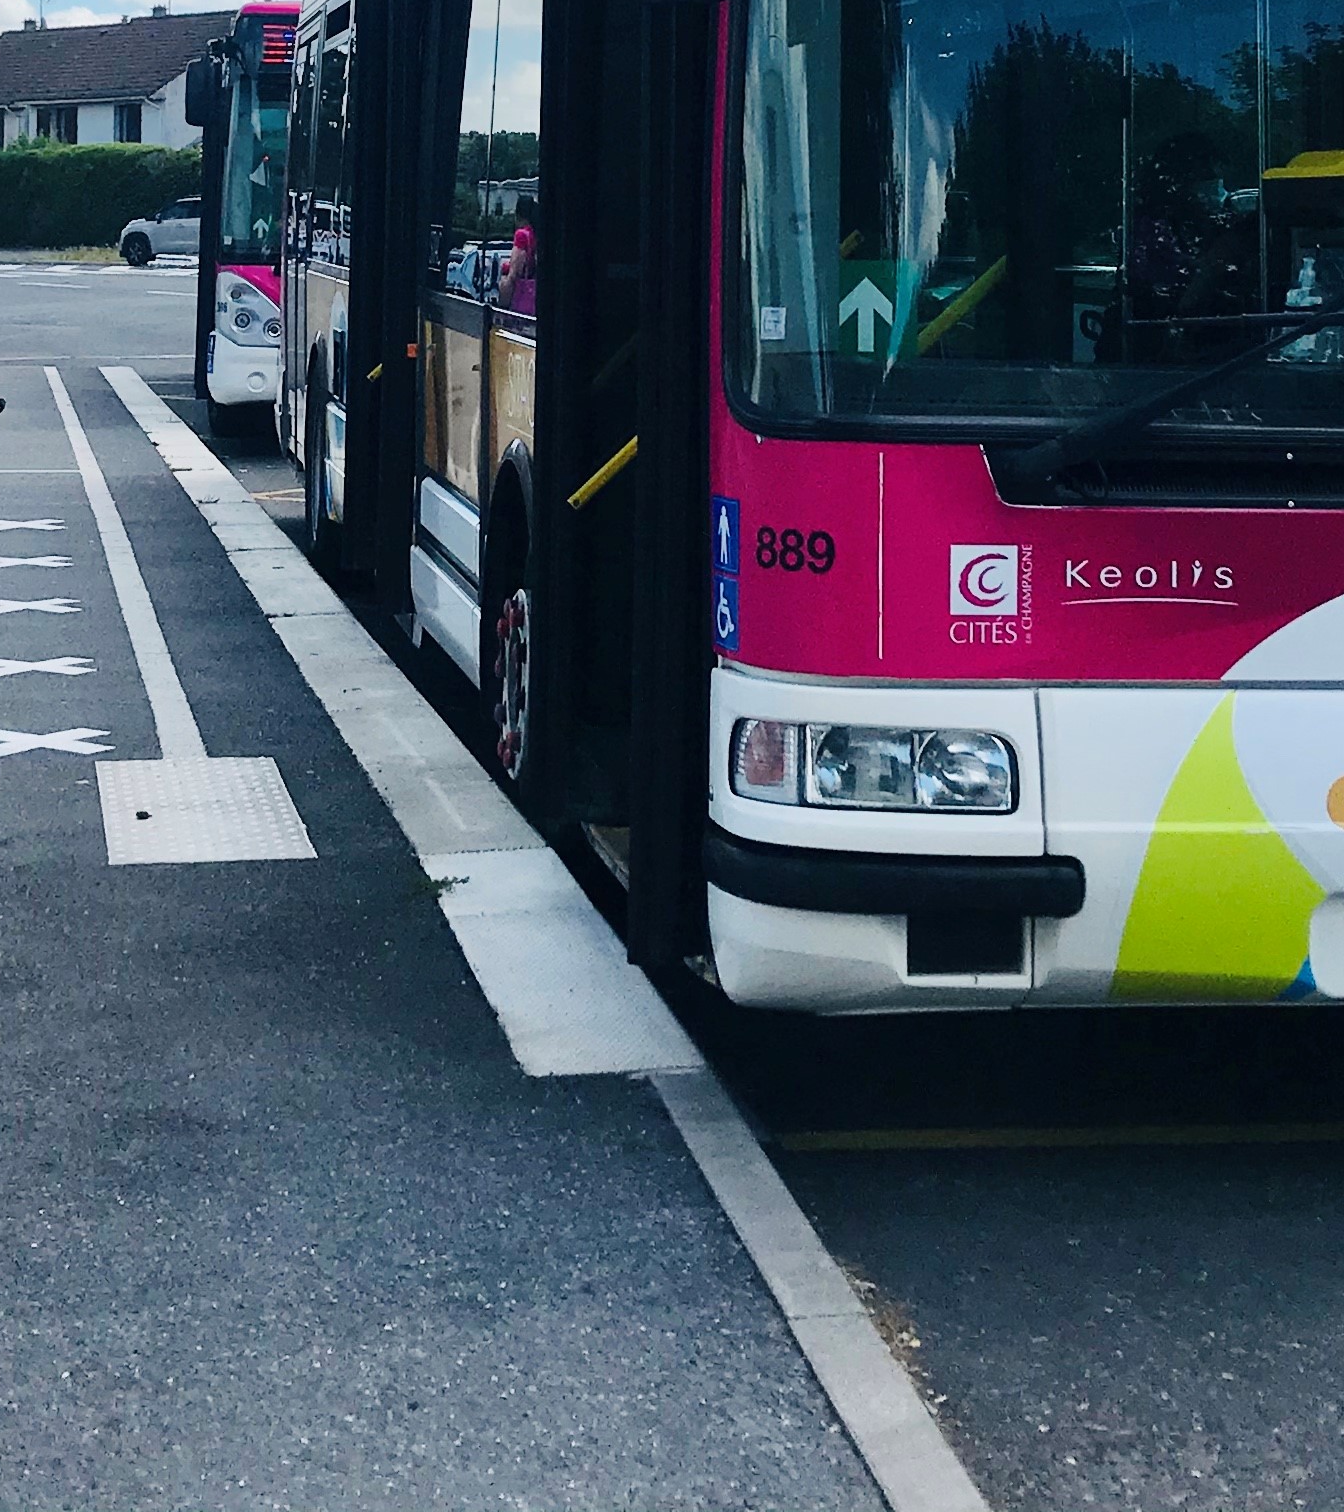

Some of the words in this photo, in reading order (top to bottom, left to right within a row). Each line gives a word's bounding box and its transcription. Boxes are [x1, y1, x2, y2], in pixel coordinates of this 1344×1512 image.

[756, 527, 835, 574] 889
[1021, 544, 1033, 630] CHAMPAGNE
[1065, 560, 1233, 588] Keolis
[950, 616, 1017, 643] CITÉS
